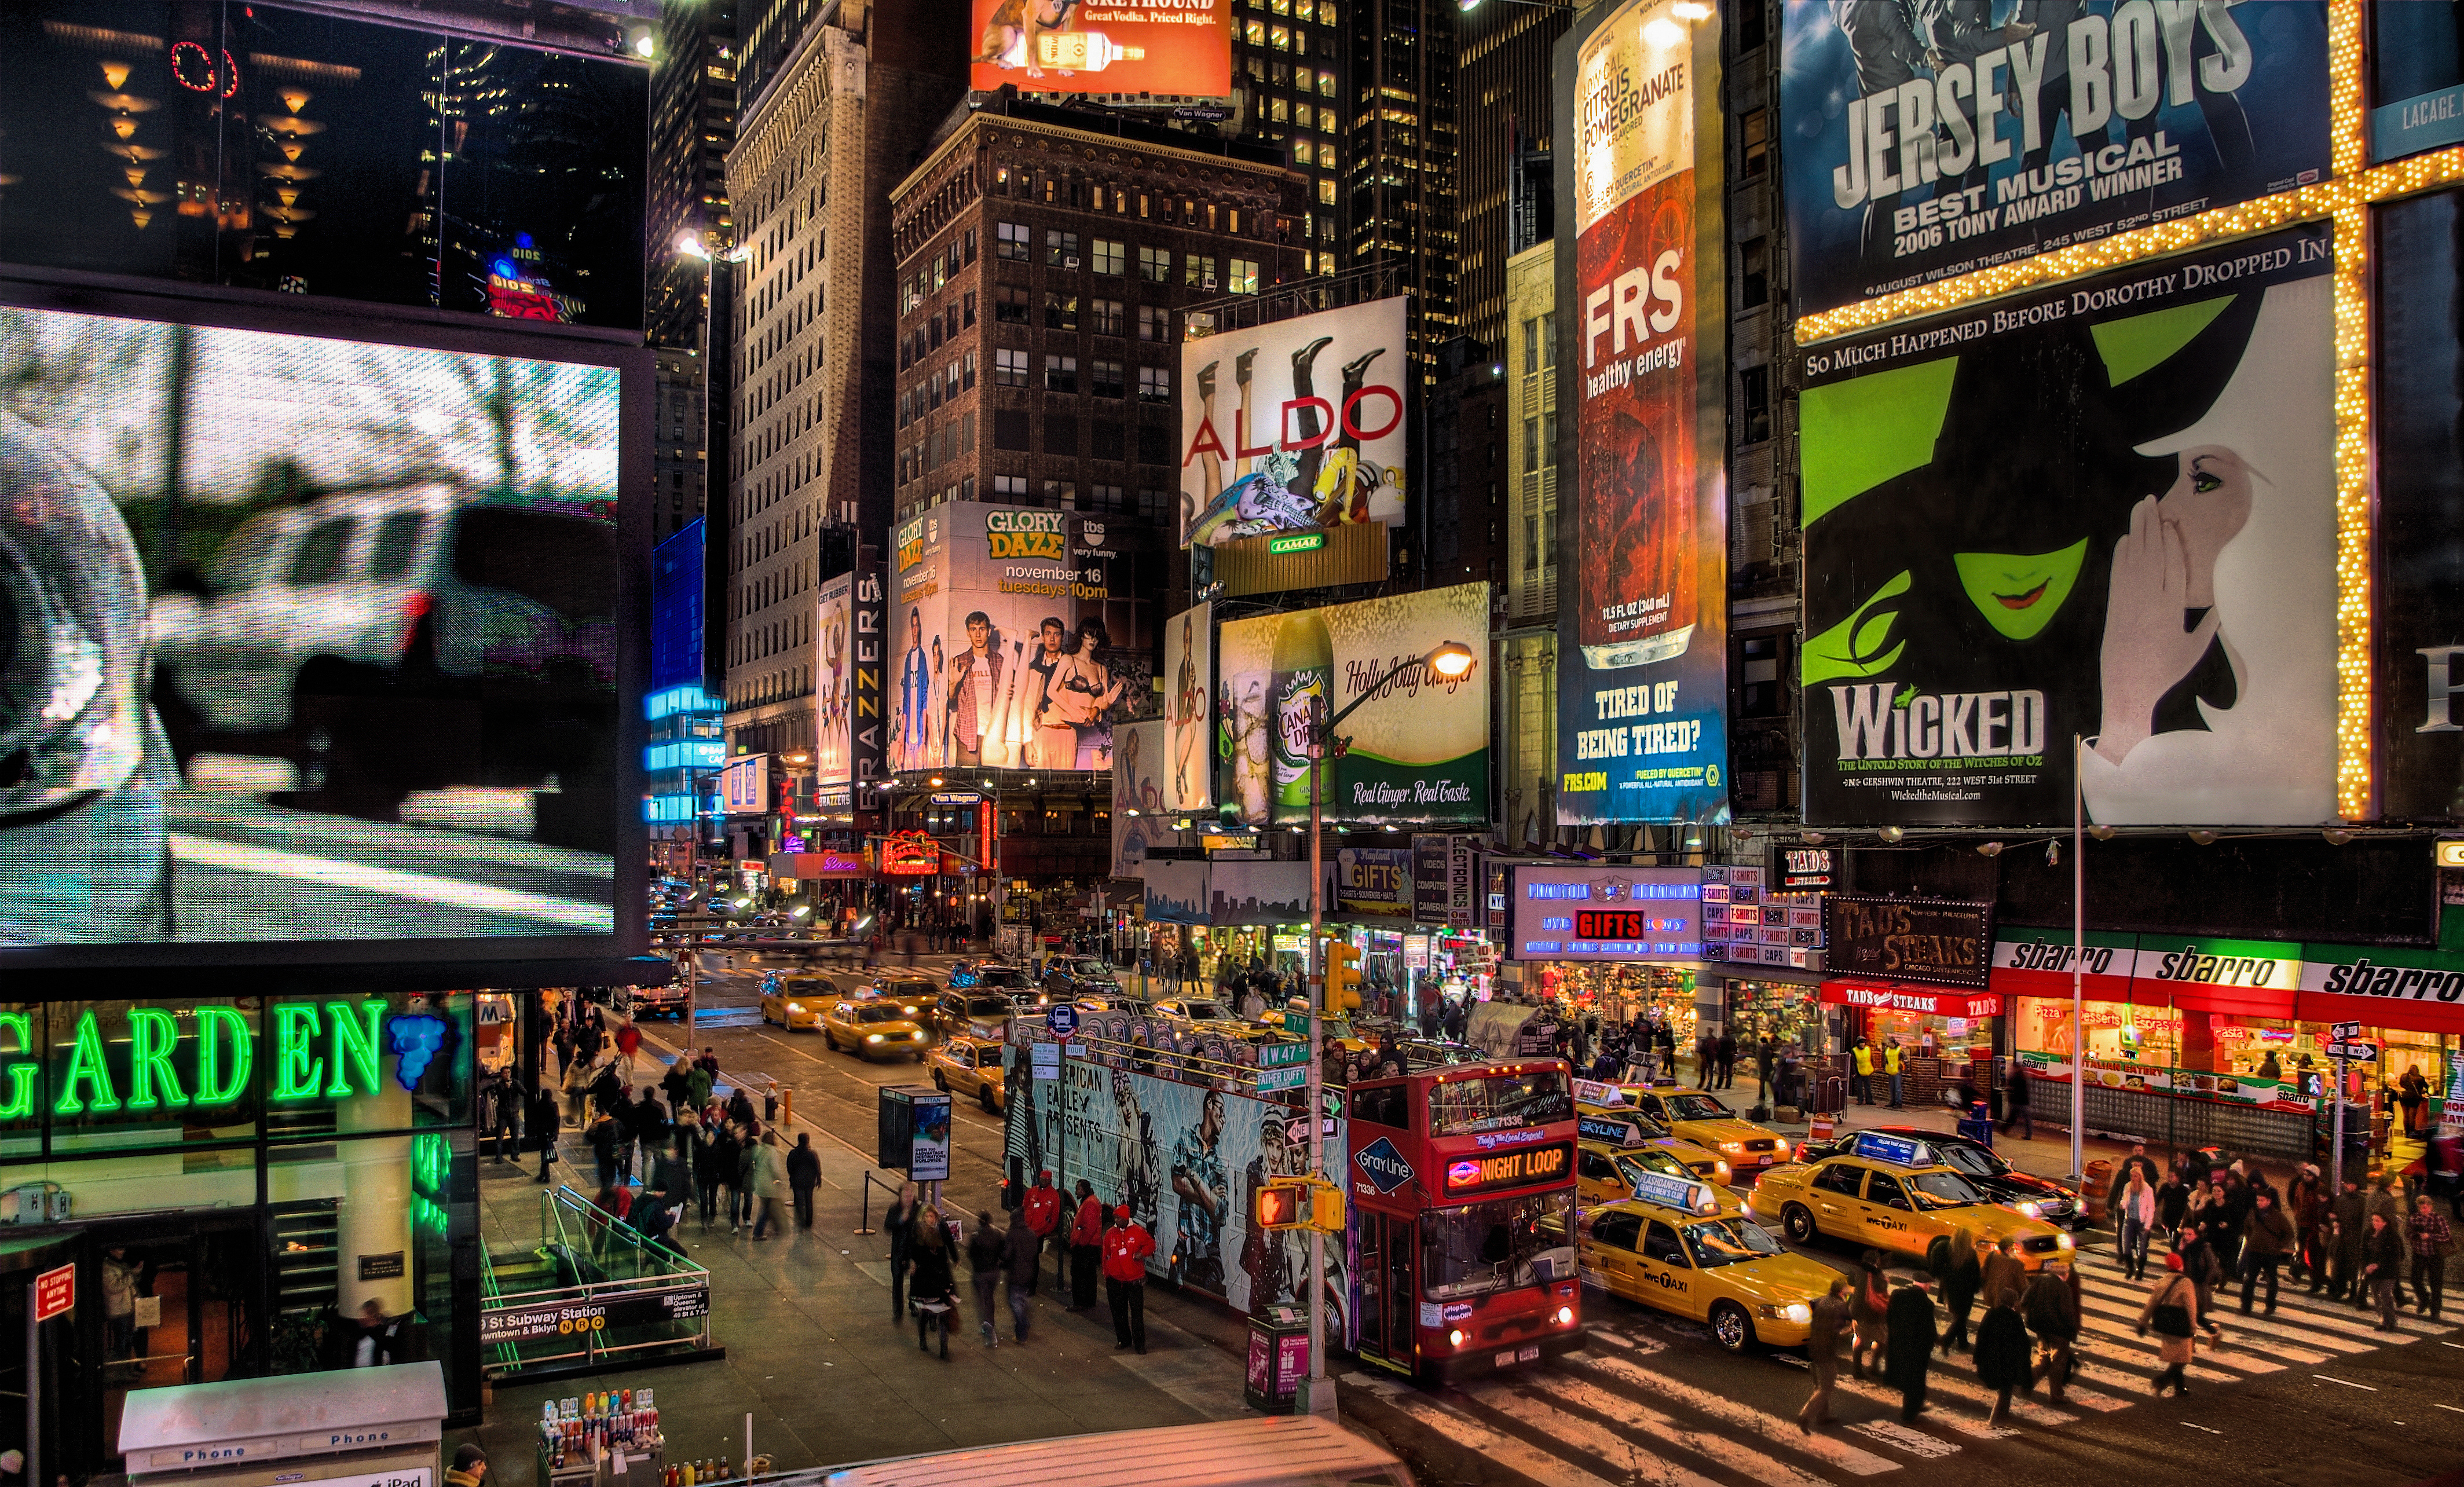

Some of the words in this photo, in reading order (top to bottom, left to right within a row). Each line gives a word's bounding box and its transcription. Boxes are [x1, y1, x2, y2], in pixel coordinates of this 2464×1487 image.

[1085, 10, 1112, 21] Great
[1112, 10, 1147, 22] Vodka.
[1150, 12, 1182, 23] Priced
[1185, 13, 1217, 25] Right.
[1584, 67, 1601, 100] LOW
[1603, 52, 1624, 80] CAL
[1584, 67, 1630, 127] CITRUS
[1833, 31, 2051, 210] JERSEY
[2068, 0, 2253, 137] BOYS
[1193, 110, 1223, 119] Wagner
[1584, 63, 1684, 155] POMEGRANATE
[1611, 115, 1643, 145] FLAVORED
[1619, 178, 1643, 198] NATURAL
[1643, 160, 1675, 183] ANTIOXIDANT
[1894, 184, 1989, 234] BEST
[1998, 131, 2180, 202] MUSICAL
[1894, 227, 1946, 258] 2006
[1947, 207, 1998, 243] TONY
[2091, 157, 2183, 202] WINNER
[1876, 273, 1924, 294] AUGUST
[1925, 260, 1975, 281] WILSON
[1976, 243, 2040, 266] THEATRE,
[2042, 235, 2070, 251] 245
[2073, 222, 2114, 241] WEST
[2151, 197, 2210, 222] STREET
[1586, 248, 1681, 369] FRS
[1587, 359, 1630, 400] healthy
[1636, 339, 1682, 376] energy
[1182, 384, 1403, 467] ALDO
[987, 511, 1064, 532] GLORY
[1083, 520, 1105, 534] tbs
[899, 516, 924, 548] GLORY
[988, 532, 1065, 561] DAZE
[1275, 536, 1319, 551] LAMAR
[1073, 547, 1092, 558] very
[1093, 547, 1118, 560] funny.
[903, 569, 928, 589] november
[929, 564, 936, 580] 16
[1006, 566, 1082, 582] november
[1085, 567, 1101, 583] 16
[998, 579, 1066, 599] tuesdays
[1068, 582, 1108, 601] 10pm
[1602, 606, 1616, 620] 11.5
[1616, 605, 1626, 618] FL
[1627, 602, 1638, 616] OZ
[1639, 597, 1655, 614] (340
[1656, 592, 1670, 610] mL)
[1609, 620, 1630, 633] DIETARY
[1631, 611, 1668, 629] SUPPLEMENT
[1346, 658, 1385, 701] Holly
[1382, 654, 1422, 698] Jolly
[858, 579, 879, 810] BRAZZERS
[1595, 684, 1650, 720] TIRED
[1654, 680, 1679, 713] OF
[1165, 687, 1206, 730] ALDO
[1577, 728, 1628, 760] BEING
[1632, 720, 1700, 756] TIRED?
[1564, 772, 1607, 792] FRS.COM
[1636, 770, 1658, 780] FUELED
[1658, 769, 1667, 779] BY
[1674, 779, 1704, 787] ANTIOXIDANT
[1862, 777, 1905, 786] GERSHWIN
[1906, 777, 1945, 788] THEATRE,
[1946, 777, 1961, 786] 222
[1963, 776, 1986, 786] WEST
[1987, 775, 2003, 785] 51st
[2005, 774, 2038, 785] STREET
[819, 793, 850, 807] BRAZZERS
[935, 794, 950, 803] Van
[951, 794, 979, 804] Wagner
[1353, 782, 1377, 806] Real
[1377, 782, 1411, 809] Ginger.
[1414, 780, 1440, 804] Real
[1440, 779, 1471, 803] Taste.
[1891, 789, 1981, 801] WickedtheMusical.com
[1422, 859, 1445, 869] VIDEOS
[1785, 849, 1830, 873] TADS
[1350, 863, 1403, 891] GIFTS
[1452, 837, 1467, 908] ELECTRONICS
[1731, 869, 1758, 882] T-SHIRTS
[1703, 888, 1729, 900] T-SHIRTS
[1418, 901, 1448, 911] CAMERAS
[1707, 907, 1724, 919] CAPS
[1731, 909, 1757, 921] T-SHIRTS
[1579, 913, 1641, 937] GIFTS
[1792, 912, 1819, 925] T-SHIRTS
[1703, 926, 1728, 938] T-SHIRTS
[1884, 935, 1976, 970] STEAKS
[2009, 937, 2114, 973] sbarro
[1905, 964, 1931, 972] CHICAGO
[2156, 945, 2276, 987] sbarro
[2323, 958, 2464, 1002] sbarro
[1846, 989, 1874, 1005] TAD'S
[1893, 994, 1937, 1012] STEAKS
[1968, 997, 1997, 1016] TAD'S
[2034, 1006, 2061, 1019] Pizza
[1291, 1016, 1298, 1031] 7
[0, 998, 389, 1118] GARDEN
[1270, 1047, 1280, 1064] W
[1282, 1045, 1296, 1061] 47
[1299, 1043, 1307, 1053] ST
[2352, 1048, 2369, 1056] WAY
[2022, 1057, 2047, 1070] sbarro
[2082, 1061, 2121, 1072] ITALIAN
[2125, 1064, 2164, 1077] EATERY
[1258, 1072, 1282, 1086] FATHER
[1283, 1069, 1305, 1082] DUFFY
[2276, 1090, 2309, 1104] sbarro
[1498, 1115, 1524, 1128] 71336
[1579, 1120, 1627, 1138] SKYLINE
[1291, 1125, 1306, 1137] ONE
[1505, 1132, 1521, 1144] Local
[1481, 1154, 1522, 1182] NIGHT
[1526, 1148, 1563, 1175] LOOP
[1356, 1182, 1375, 1196] 71336
[1639, 1173, 1689, 1193] FLASHDANCERS
[1639, 1183, 1671, 1198] GENTLEMEN'S
[1672, 1191, 1683, 1200] CLUB
[1644, 1272, 1660, 1284] NYC
[1660, 1272, 1687, 1293] TAXI
[673, 1293, 697, 1301] Uptown
[673, 1299, 696, 1307] Queens
[489, 1317, 504, 1329] St
[507, 1312, 558, 1327] Subway
[561, 1305, 606, 1320] Station
[1448, 1305, 1460, 1313] Hop
[1448, 1313, 1460, 1321] Hop
[522, 1326, 530, 1334] &
[532, 1324, 557, 1334] Bklyn
[331, 1431, 389, 1446] Phone
[184, 1447, 246, 1462] Phone
[387, 1475, 421, 1487] iPad
